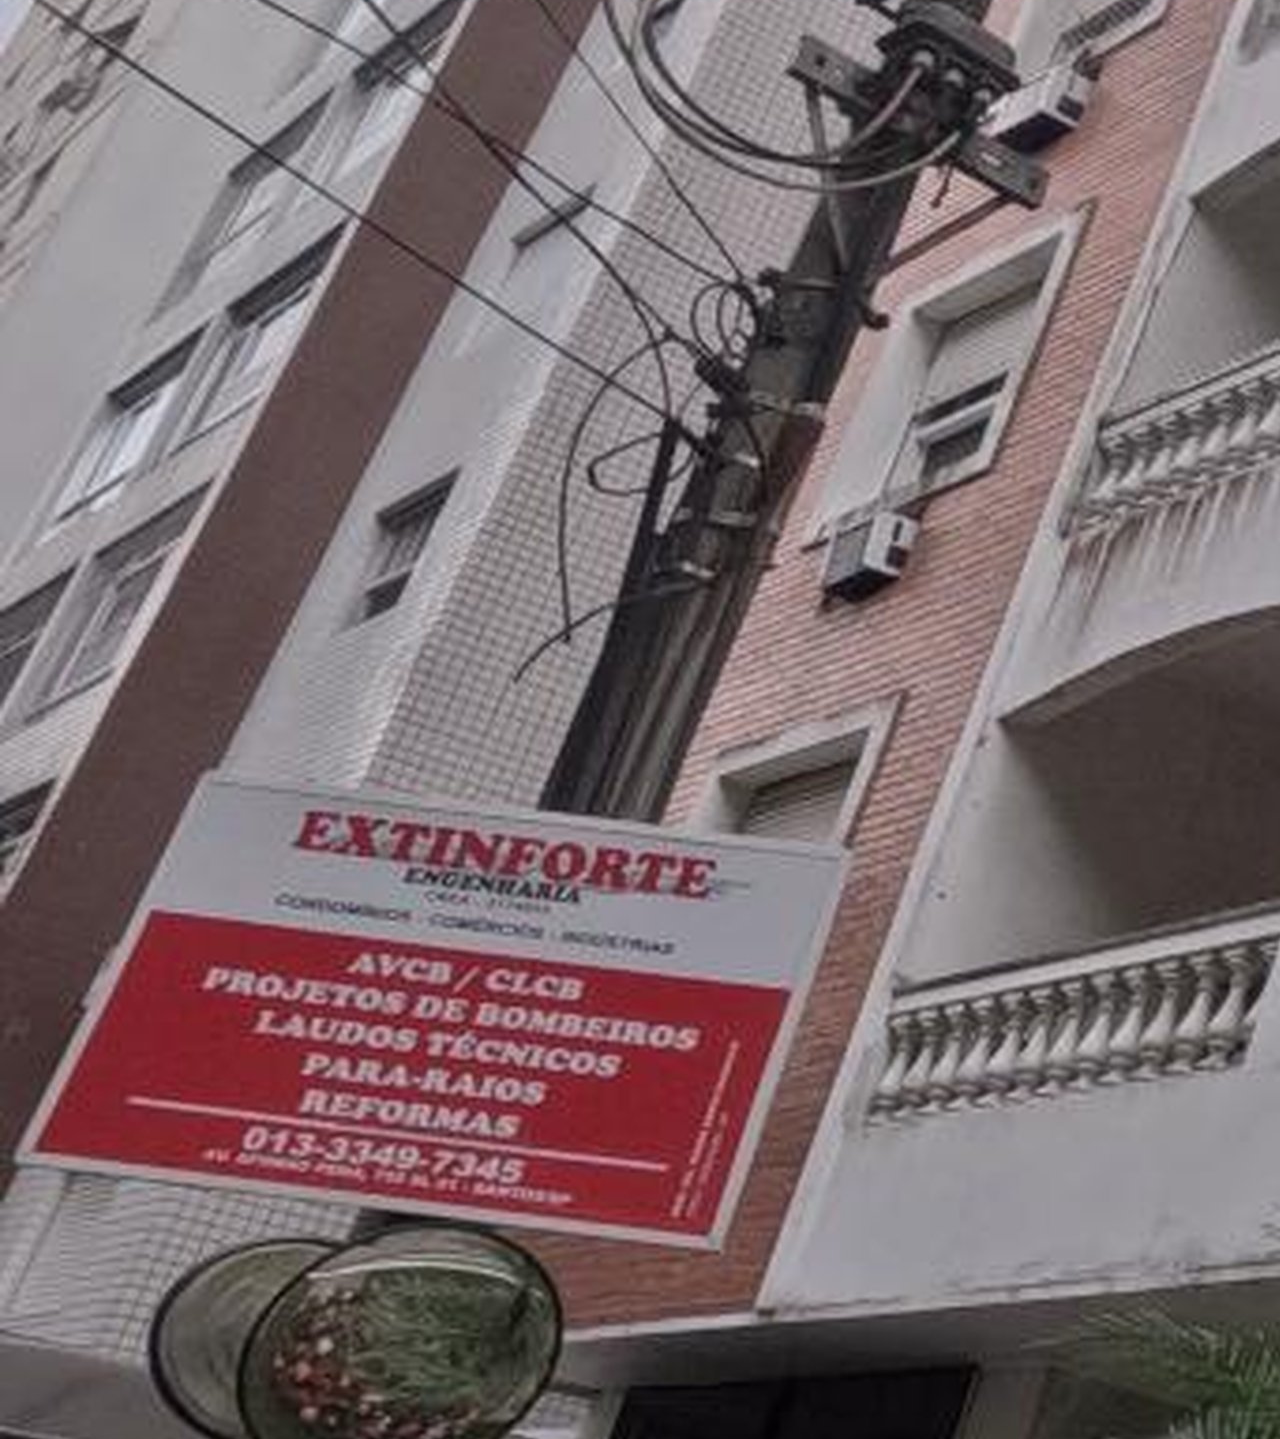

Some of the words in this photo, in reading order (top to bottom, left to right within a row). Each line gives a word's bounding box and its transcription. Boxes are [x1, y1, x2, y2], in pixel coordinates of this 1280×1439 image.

[294, 809, 717, 900] EXTINFORTE
[402, 866, 582, 906] ENGENHARIA
[348, 951, 452, 985] AVCB
[484, 968, 585, 1001] CLCB
[201, 967, 409, 1015] PROJETOS
[415, 994, 469, 1023] DE
[474, 1001, 700, 1052] BOMBEIROS
[253, 1009, 419, 1053] LAUDOS
[426, 1031, 623, 1078] TÉCNICOS
[300, 1052, 548, 1106] PARA-RAIOS
[300, 1088, 522, 1139] REFORMAS
[242, 1125, 526, 1185] 013-3349-7345
